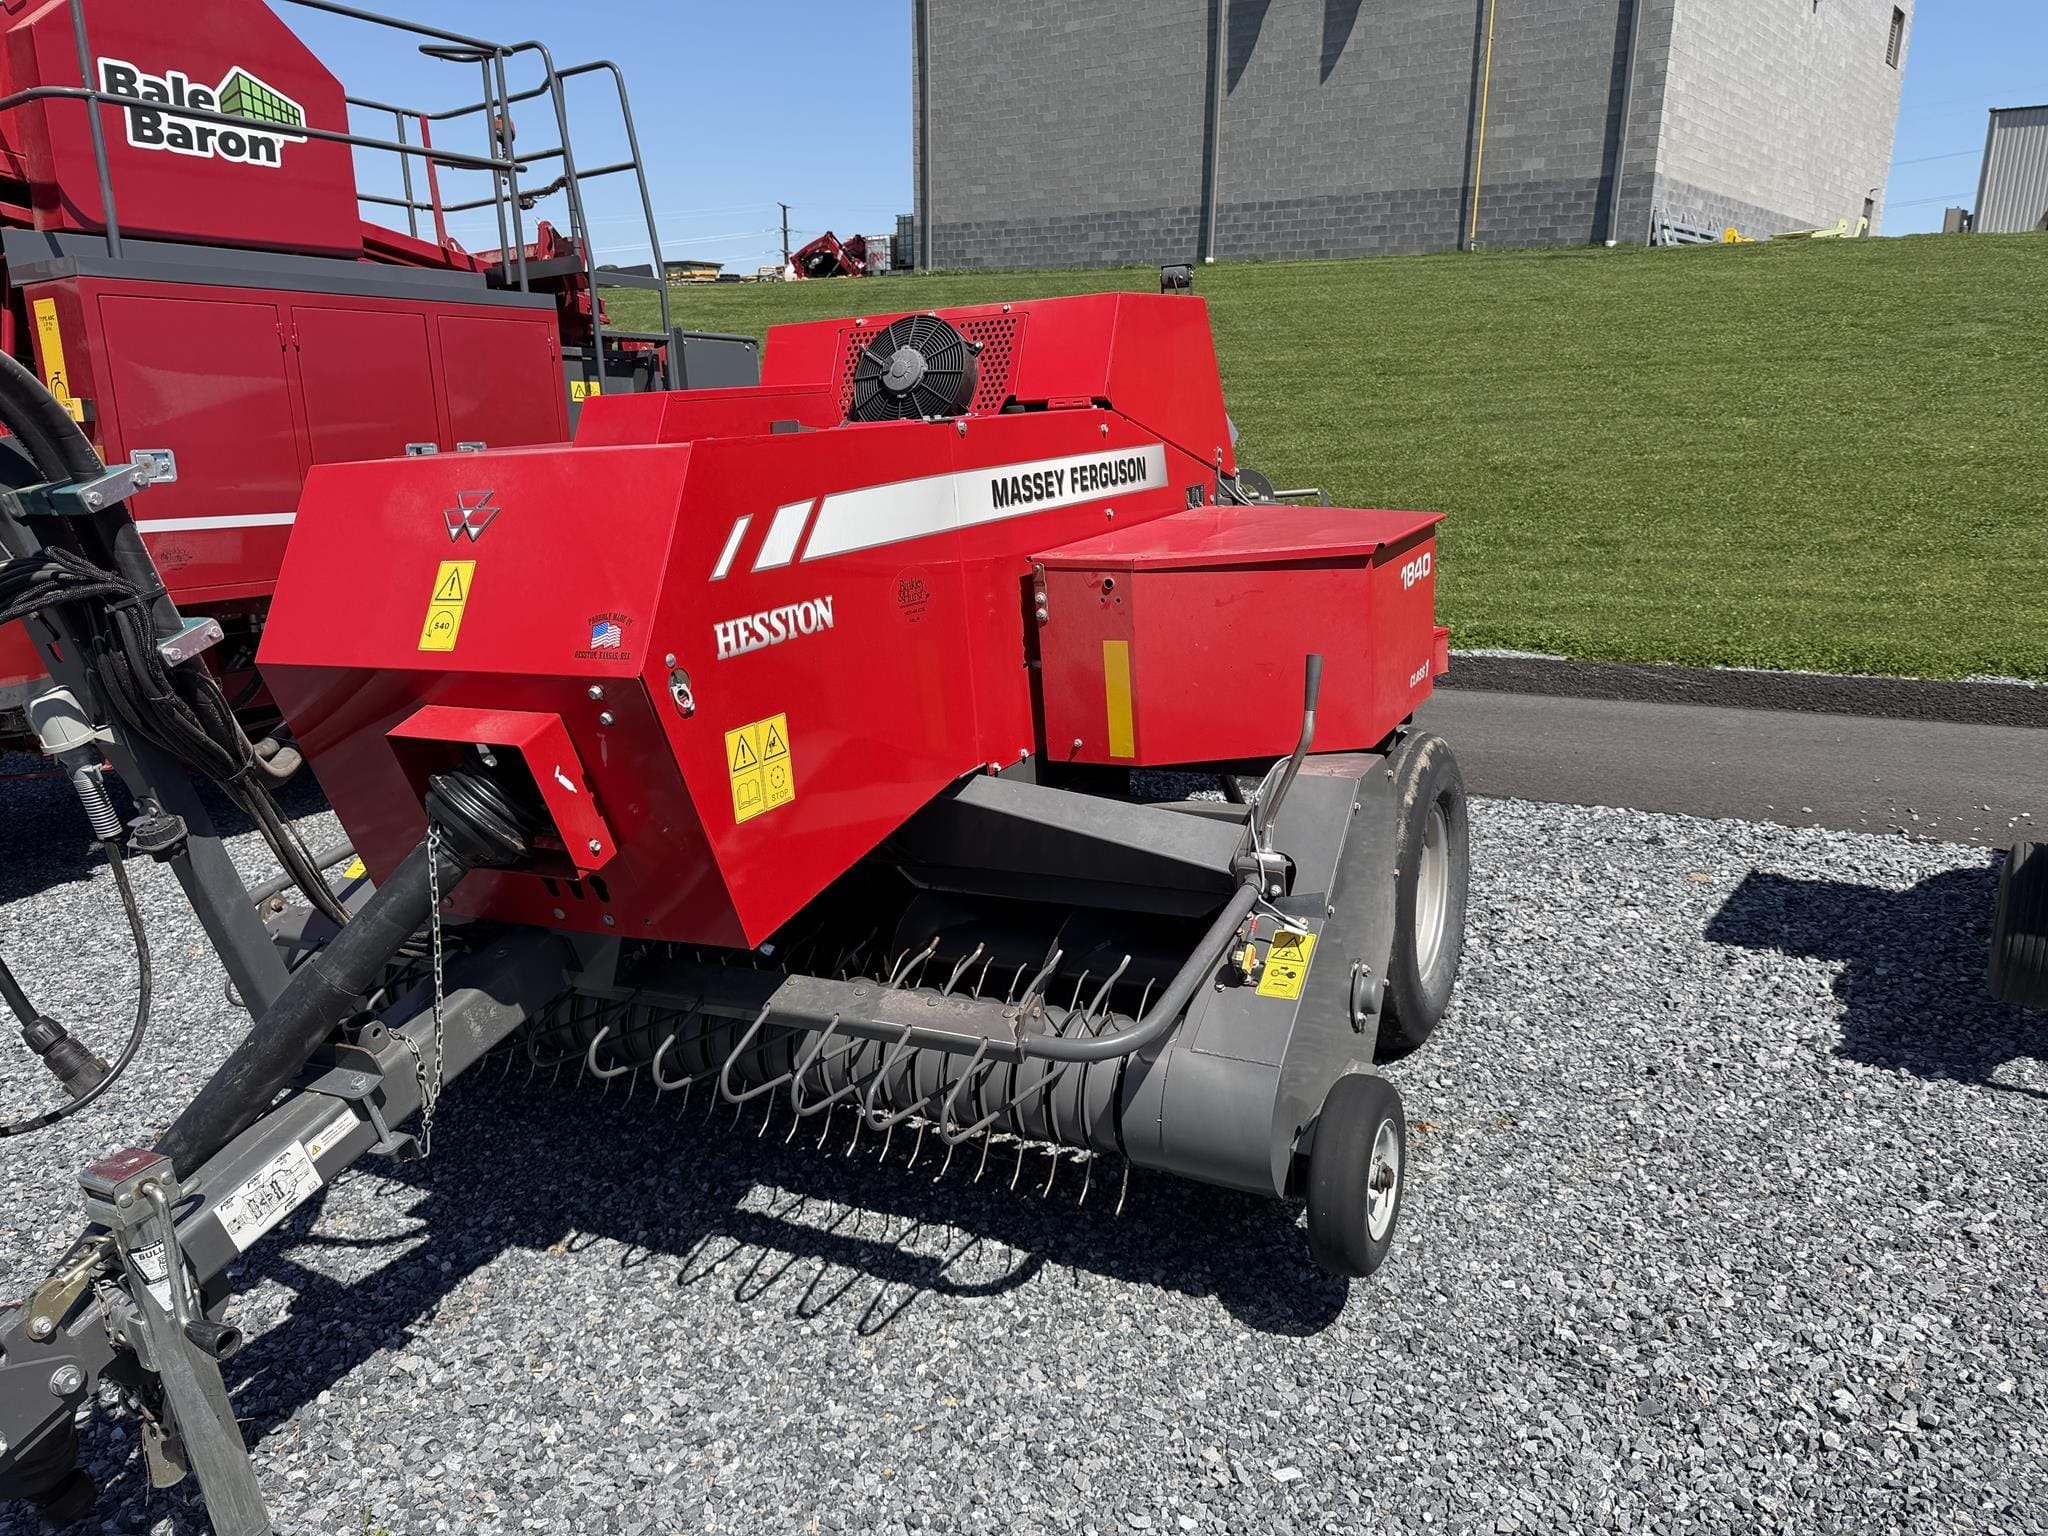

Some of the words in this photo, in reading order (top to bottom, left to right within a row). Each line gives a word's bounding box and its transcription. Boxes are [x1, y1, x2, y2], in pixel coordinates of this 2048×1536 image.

[103, 63, 215, 110] Bale
[130, 106, 278, 163] Baron
[991, 469, 1065, 509] MASSEY
[1070, 456, 1147, 494] FERGUSON
[1400, 552, 1431, 590] 1840
[434, 622, 450, 630] 540
[713, 595, 834, 660] HESSTON
[1409, 664, 1426, 688] CLASS
[771, 789, 789, 802] STOP
[138, 1247, 165, 1261] BULL
